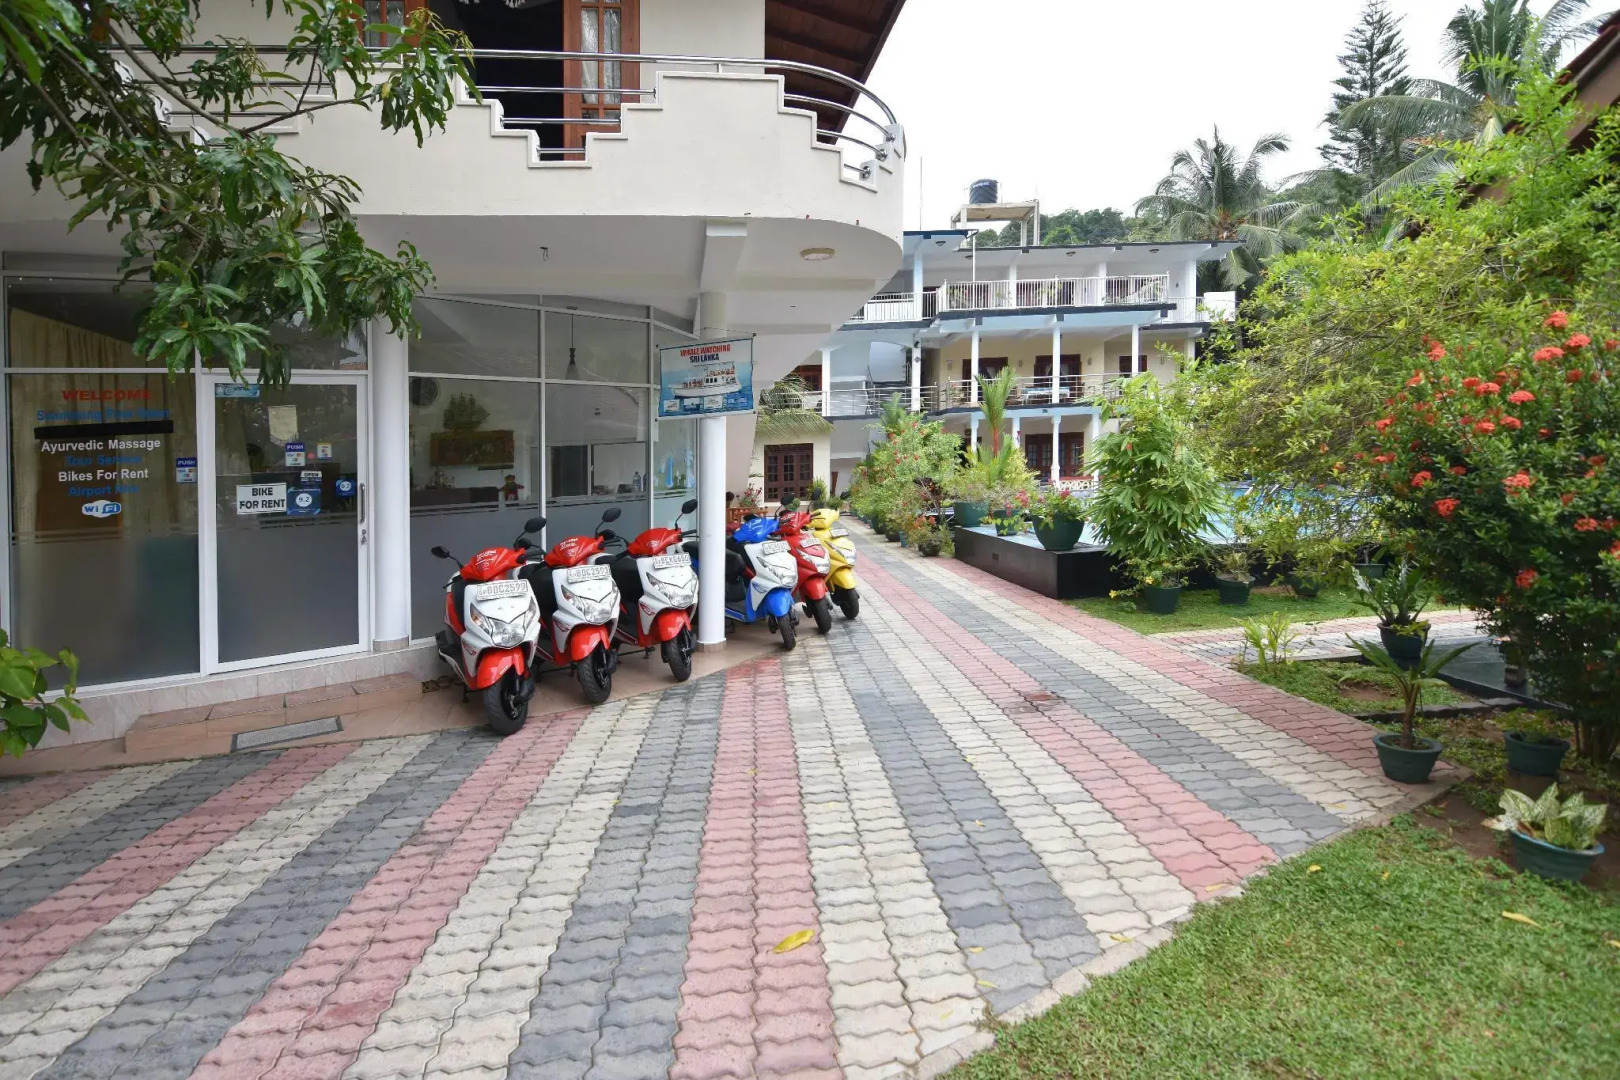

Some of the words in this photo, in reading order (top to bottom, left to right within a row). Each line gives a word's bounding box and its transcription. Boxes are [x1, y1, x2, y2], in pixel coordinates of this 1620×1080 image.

[701, 344, 731, 353] WATCHING
[690, 355, 700, 363] SRI
[701, 354, 719, 362] LANKA
[62, 390, 151, 400] WELCOME
[41, 440, 104, 454] Ayurvedic
[108, 439, 161, 450] Massage
[58, 471, 92, 482] Bikes
[96, 469, 117, 480] For
[121, 468, 149, 479] Rent
[68, 485, 111, 497] Airport
[251, 487, 273, 497] BIKE
[239, 500, 259, 509] FOR
[261, 498, 286, 508] RENT
